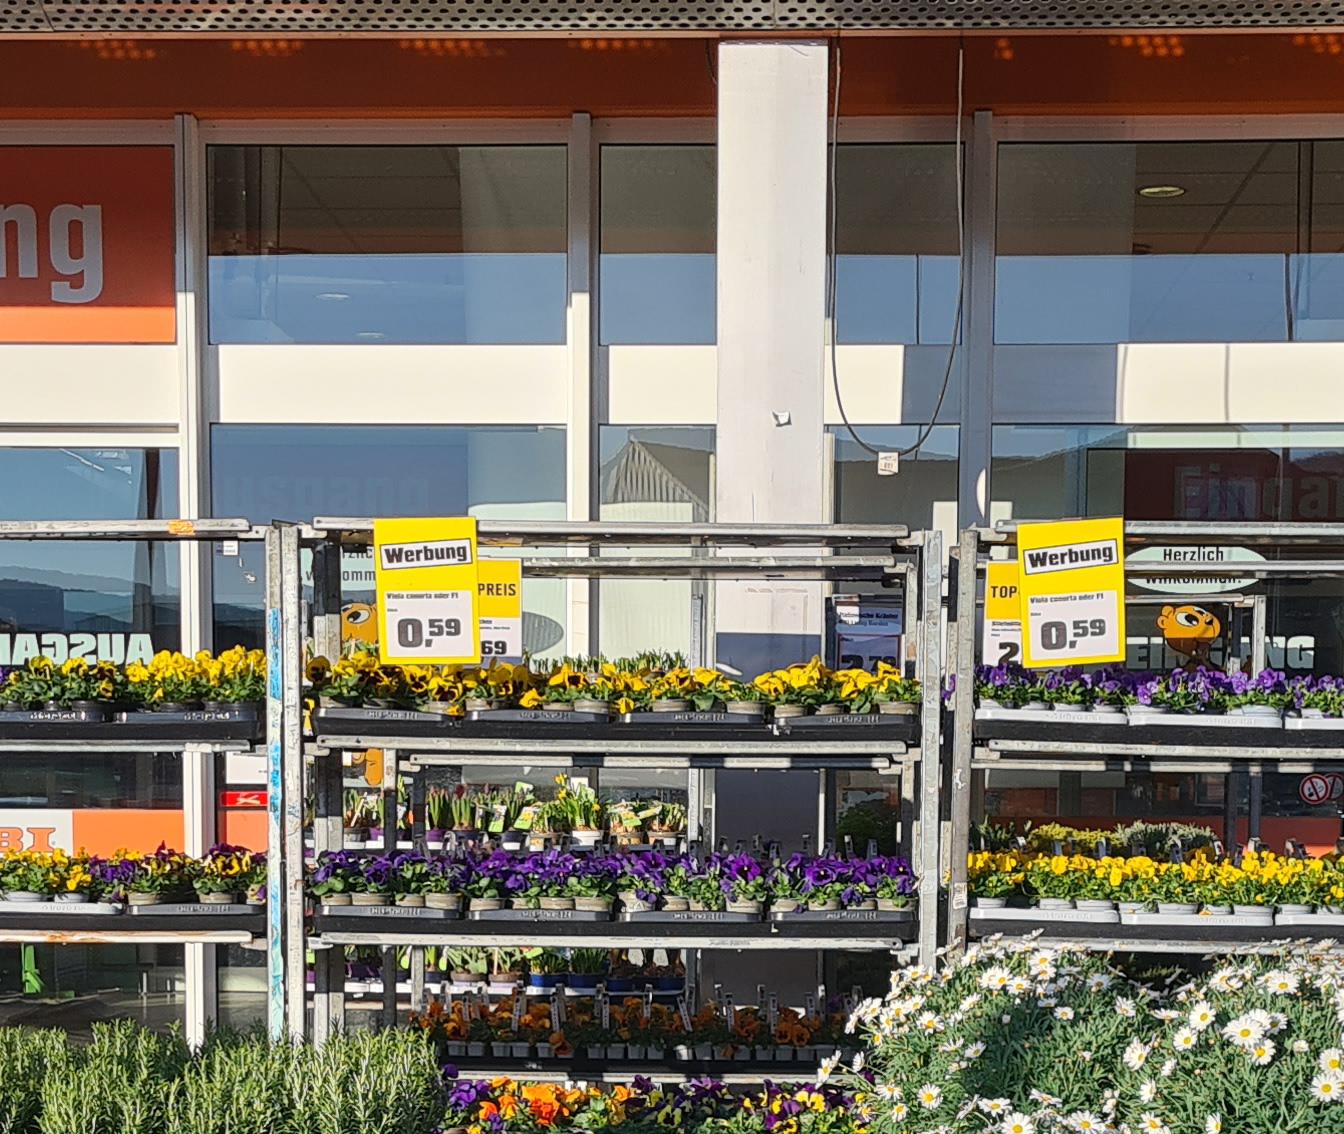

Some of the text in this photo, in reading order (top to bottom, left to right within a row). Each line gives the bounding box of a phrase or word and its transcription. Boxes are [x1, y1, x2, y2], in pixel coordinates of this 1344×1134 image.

[384, 545, 467, 564] Werbung
[1028, 546, 1113, 568] Werbung
[478, 583, 516, 596] PREIS
[397, 618, 461, 648] 0,59
[1041, 618, 1106, 650] 0,59
